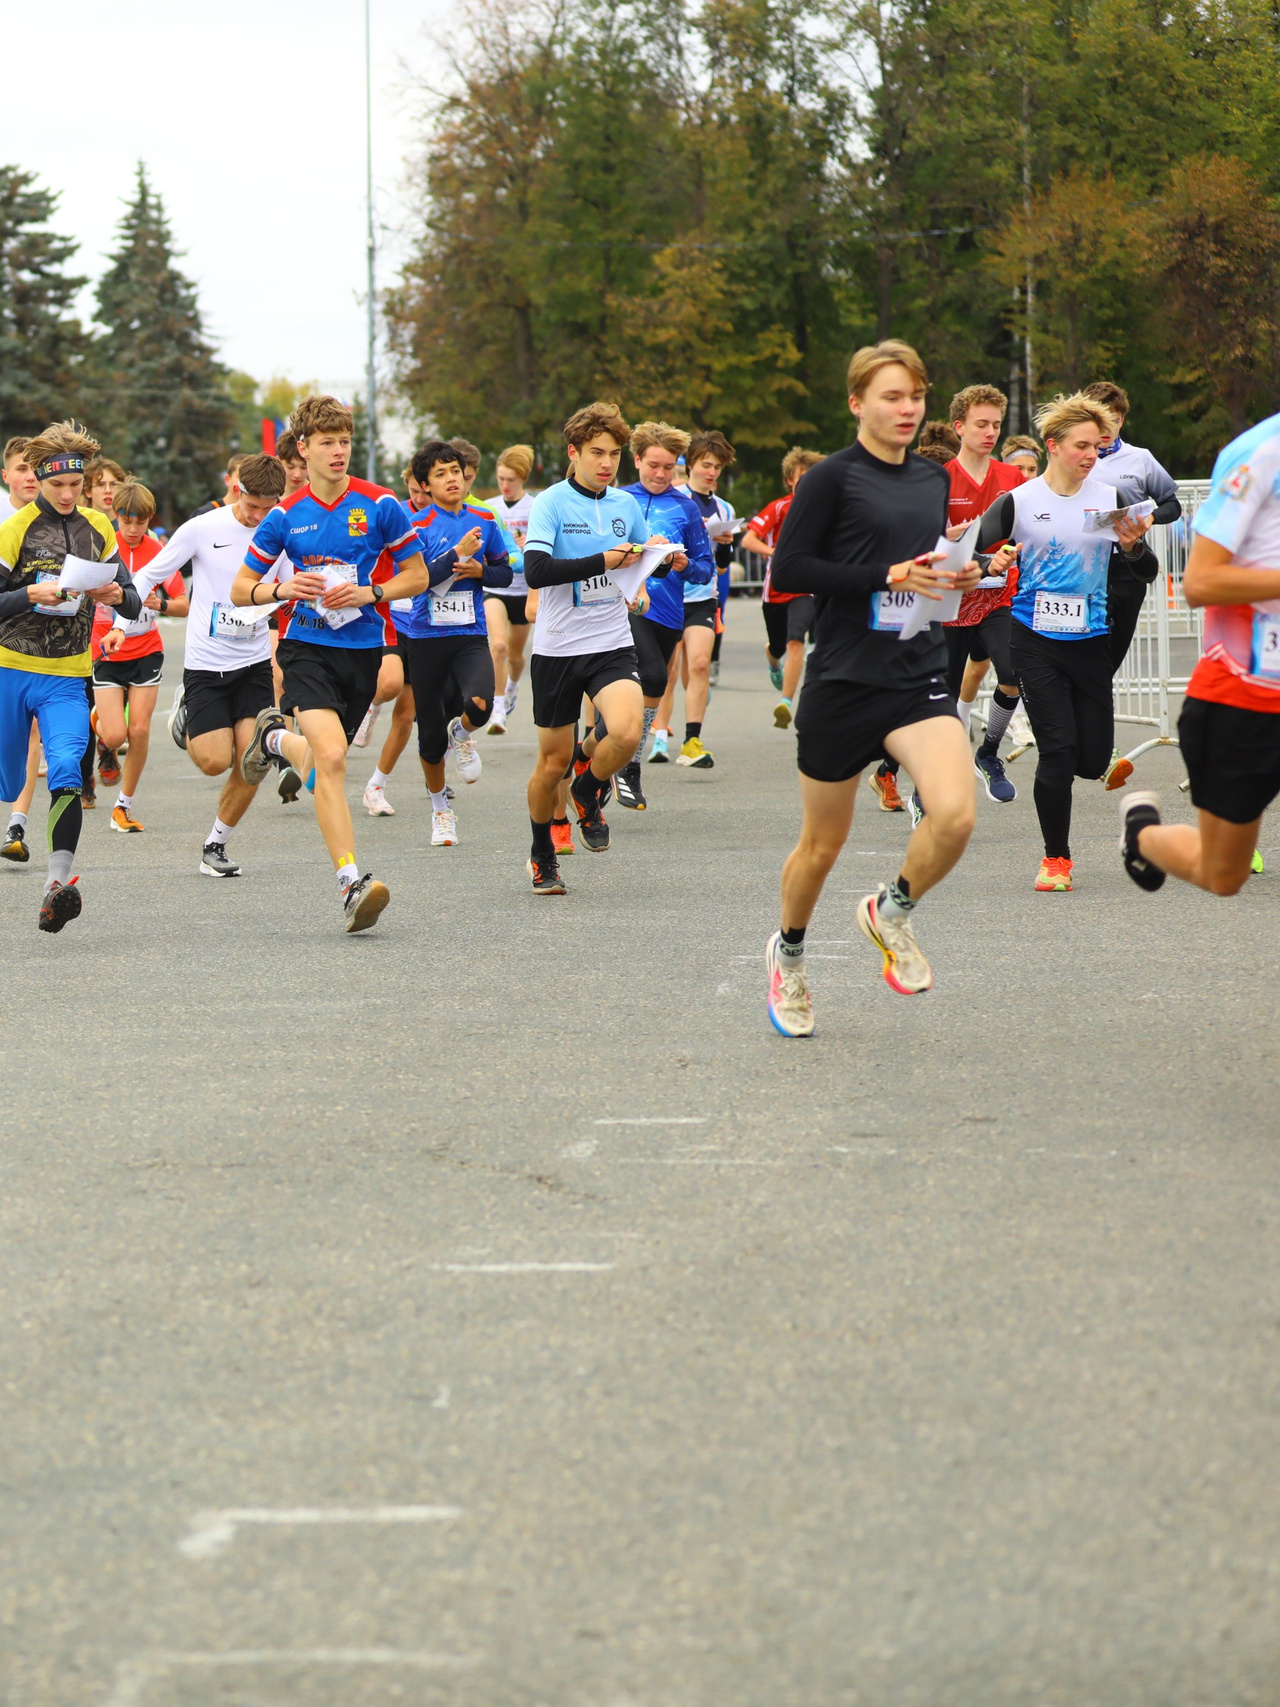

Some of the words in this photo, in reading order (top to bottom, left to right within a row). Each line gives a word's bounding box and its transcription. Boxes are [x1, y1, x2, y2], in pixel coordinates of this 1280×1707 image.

[290, 526, 309, 534] СШОР
[582, 575, 612, 592] 310.
[434, 601, 466, 612] 354.1
[1042, 601, 1082, 617] 333.1
[312, 617, 325, 630] 18
